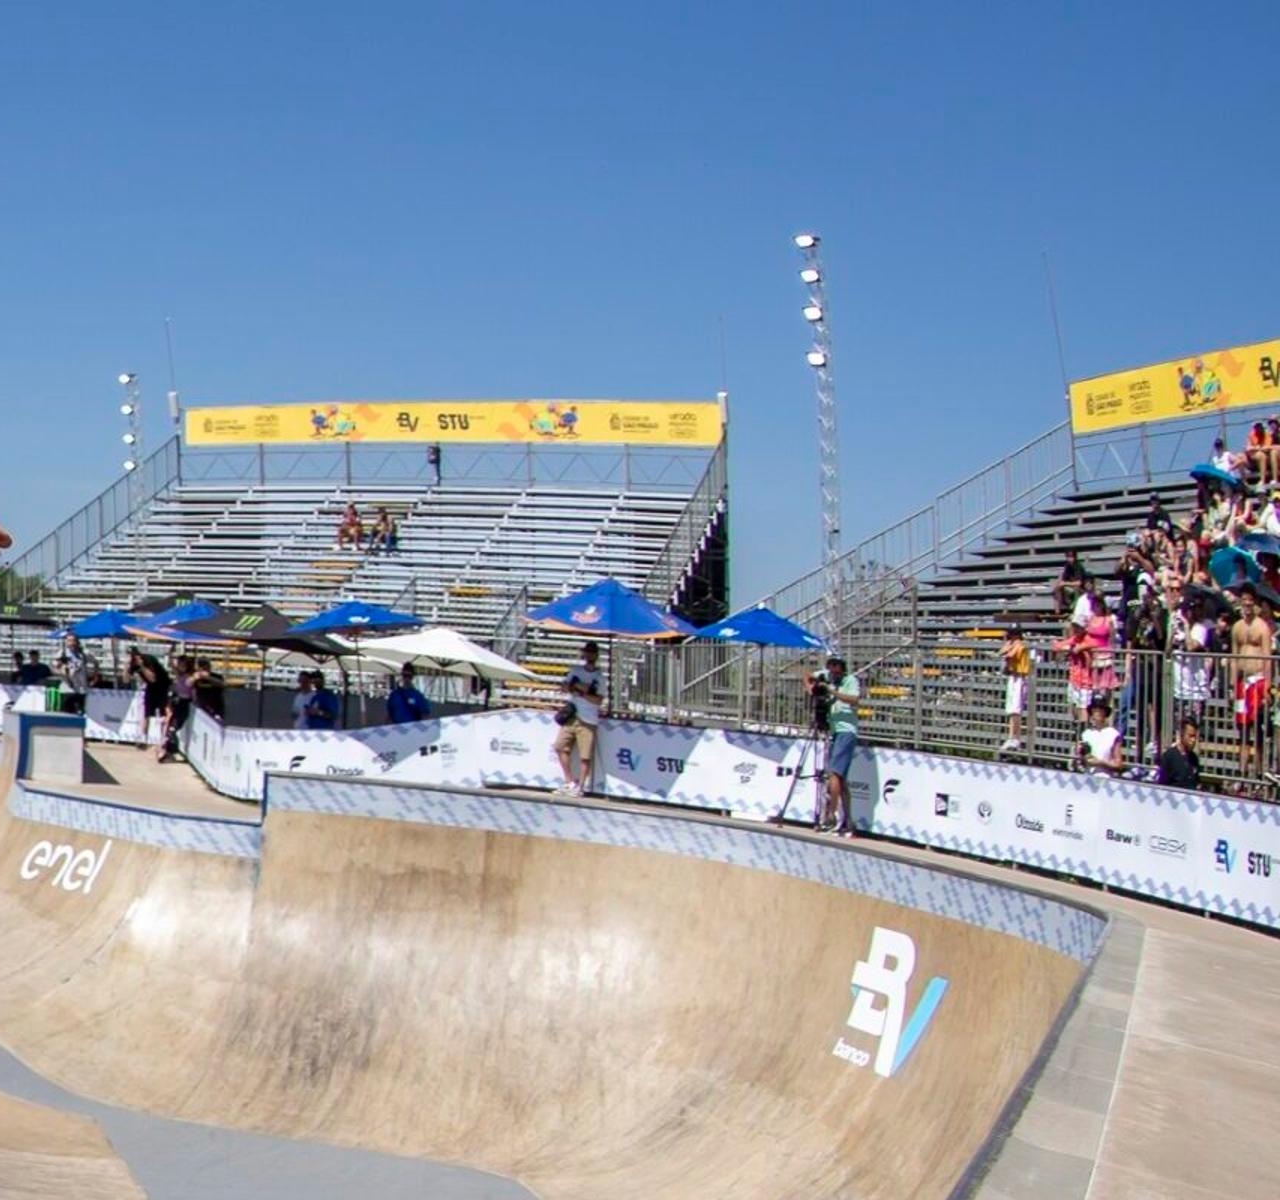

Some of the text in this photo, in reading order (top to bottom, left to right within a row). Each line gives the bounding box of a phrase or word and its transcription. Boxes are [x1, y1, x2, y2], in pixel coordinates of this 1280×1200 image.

[438, 413, 470, 430] STU
[657, 757, 684, 773] STU
[20, 839, 113, 895] enel
[1248, 851, 1272, 878] STU
